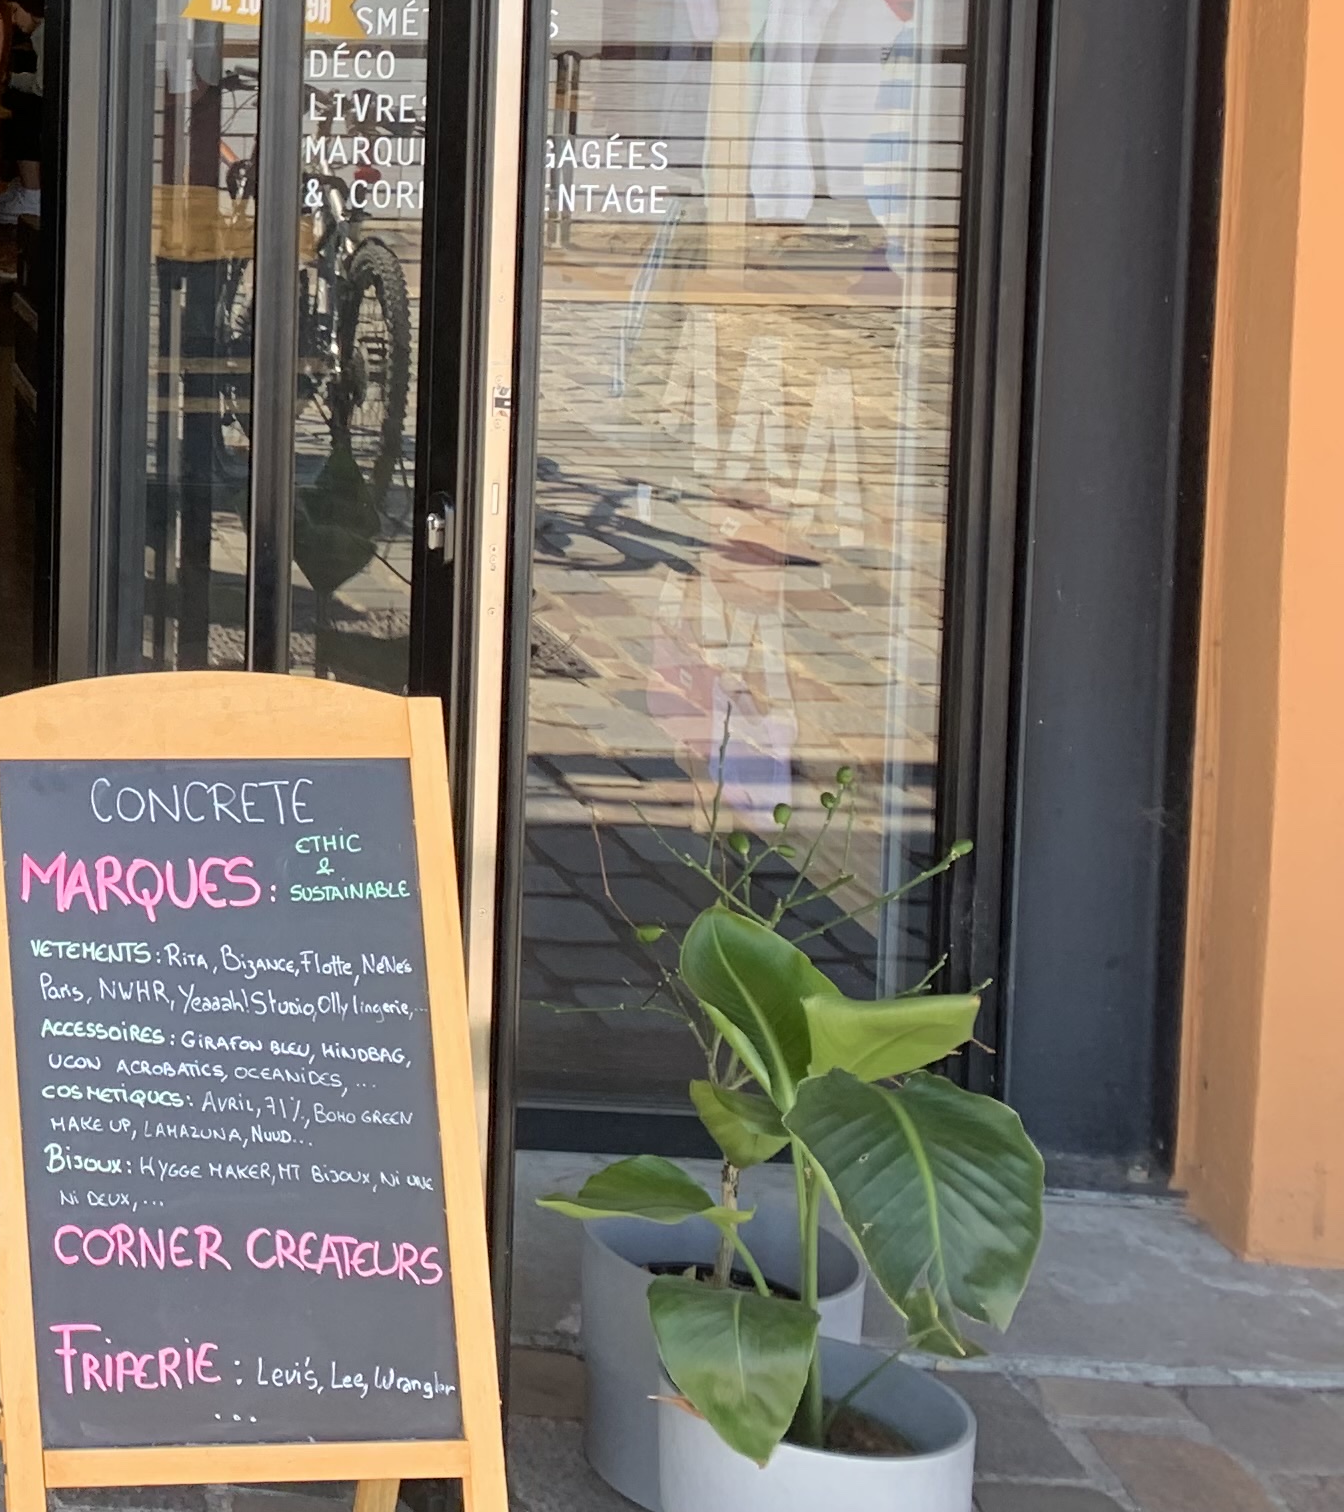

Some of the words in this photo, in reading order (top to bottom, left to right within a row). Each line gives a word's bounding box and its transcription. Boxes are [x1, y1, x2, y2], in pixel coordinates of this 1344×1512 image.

[309, 42, 396, 79] DÉCO
[304, 178, 324, 209] &
[90, 777, 314, 825] CONCRETE
[315, 857, 336, 877] &
[48, 1053, 102, 1071] UCON
[49, 1115, 104, 1133] MAKE
[109, 1117, 137, 1141] UP,
[361, 1109, 414, 1126] GREEN
[139, 1155, 203, 1182] HYGGE
[208, 1162, 276, 1186] MAKER,
[277, 1163, 301, 1181] MT
[53, 1222, 232, 1271] CORNER
[246, 1226, 444, 1286] CREATEURS
[330, 1360, 369, 1399] Lee,
